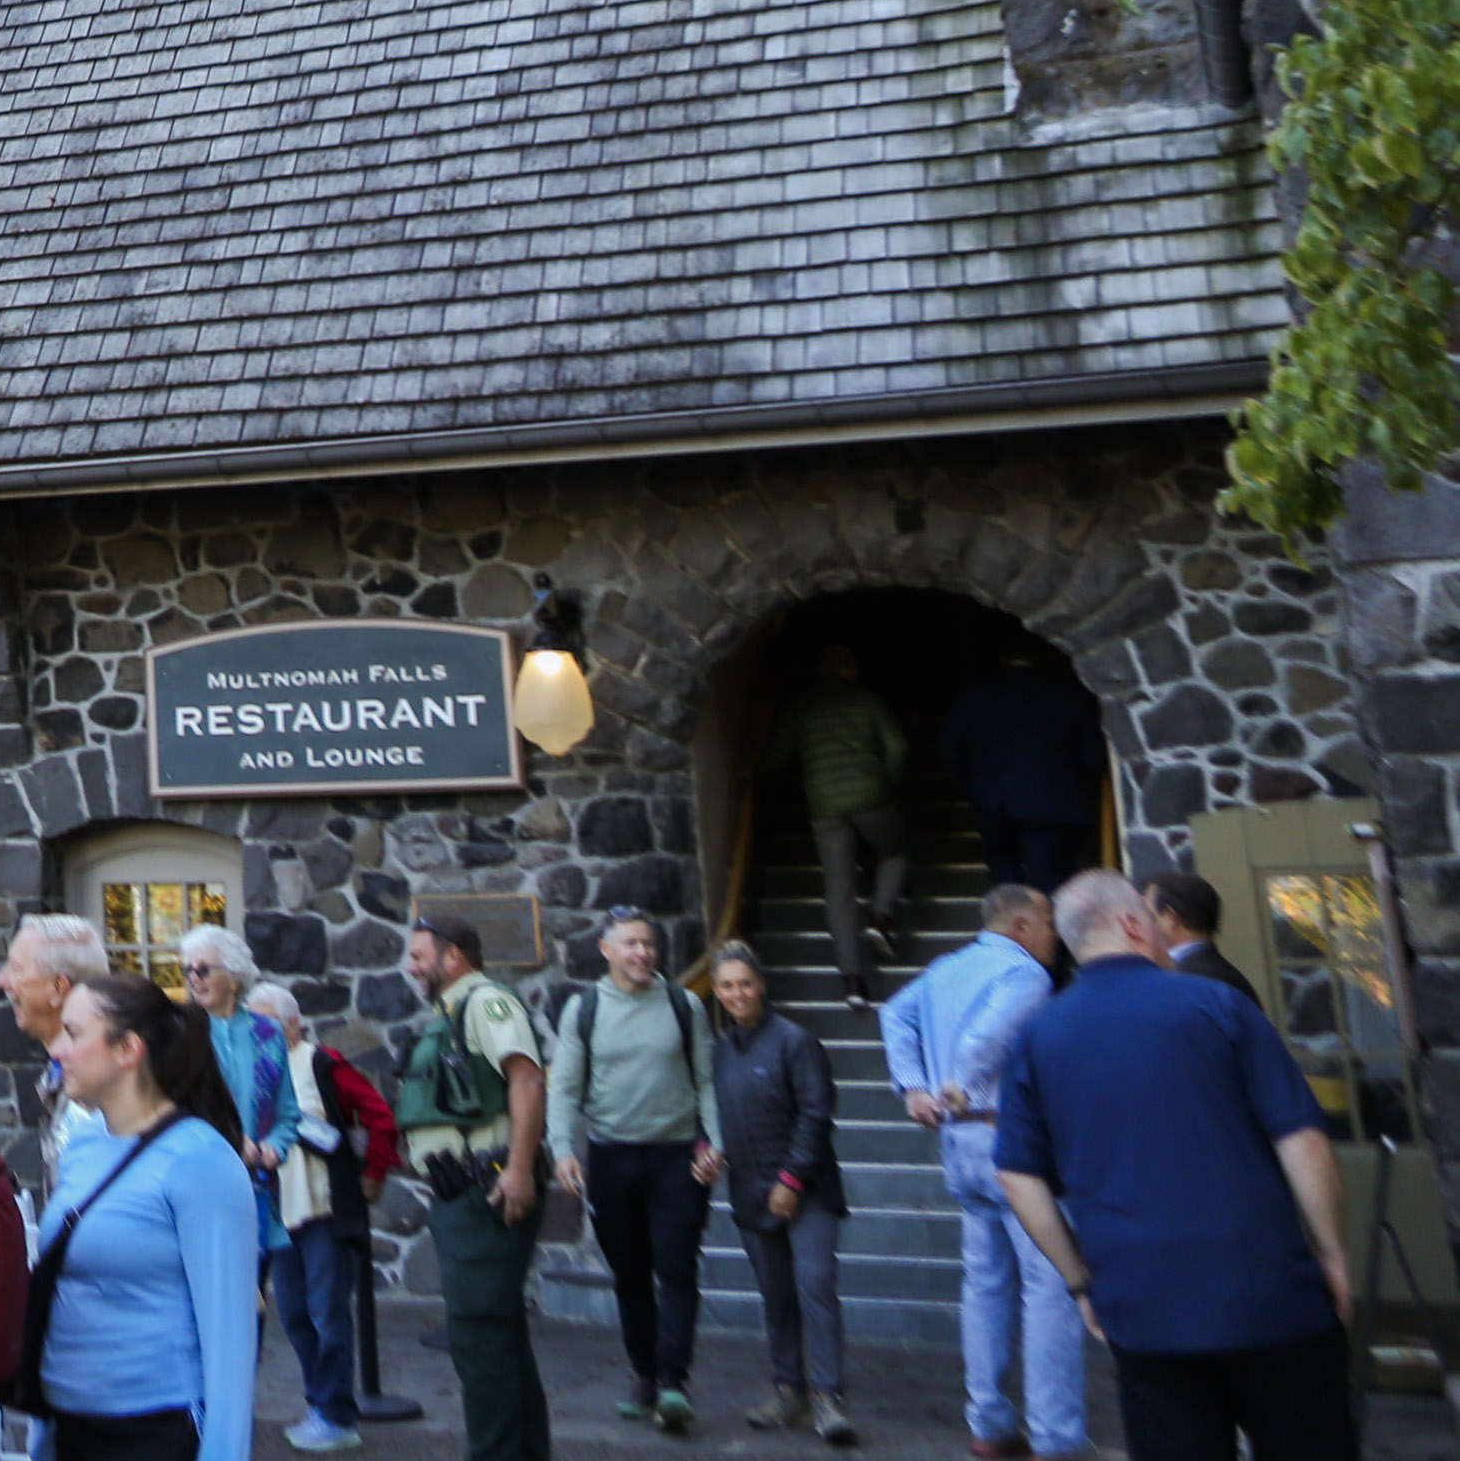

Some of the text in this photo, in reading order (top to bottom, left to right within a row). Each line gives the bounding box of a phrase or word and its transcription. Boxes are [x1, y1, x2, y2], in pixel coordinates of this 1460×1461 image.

[207, 664, 448, 690] MULTNOMAH FALLS
[175, 694, 486, 738] RESTAURANT
[239, 745, 425, 771] AND LOUNGE
